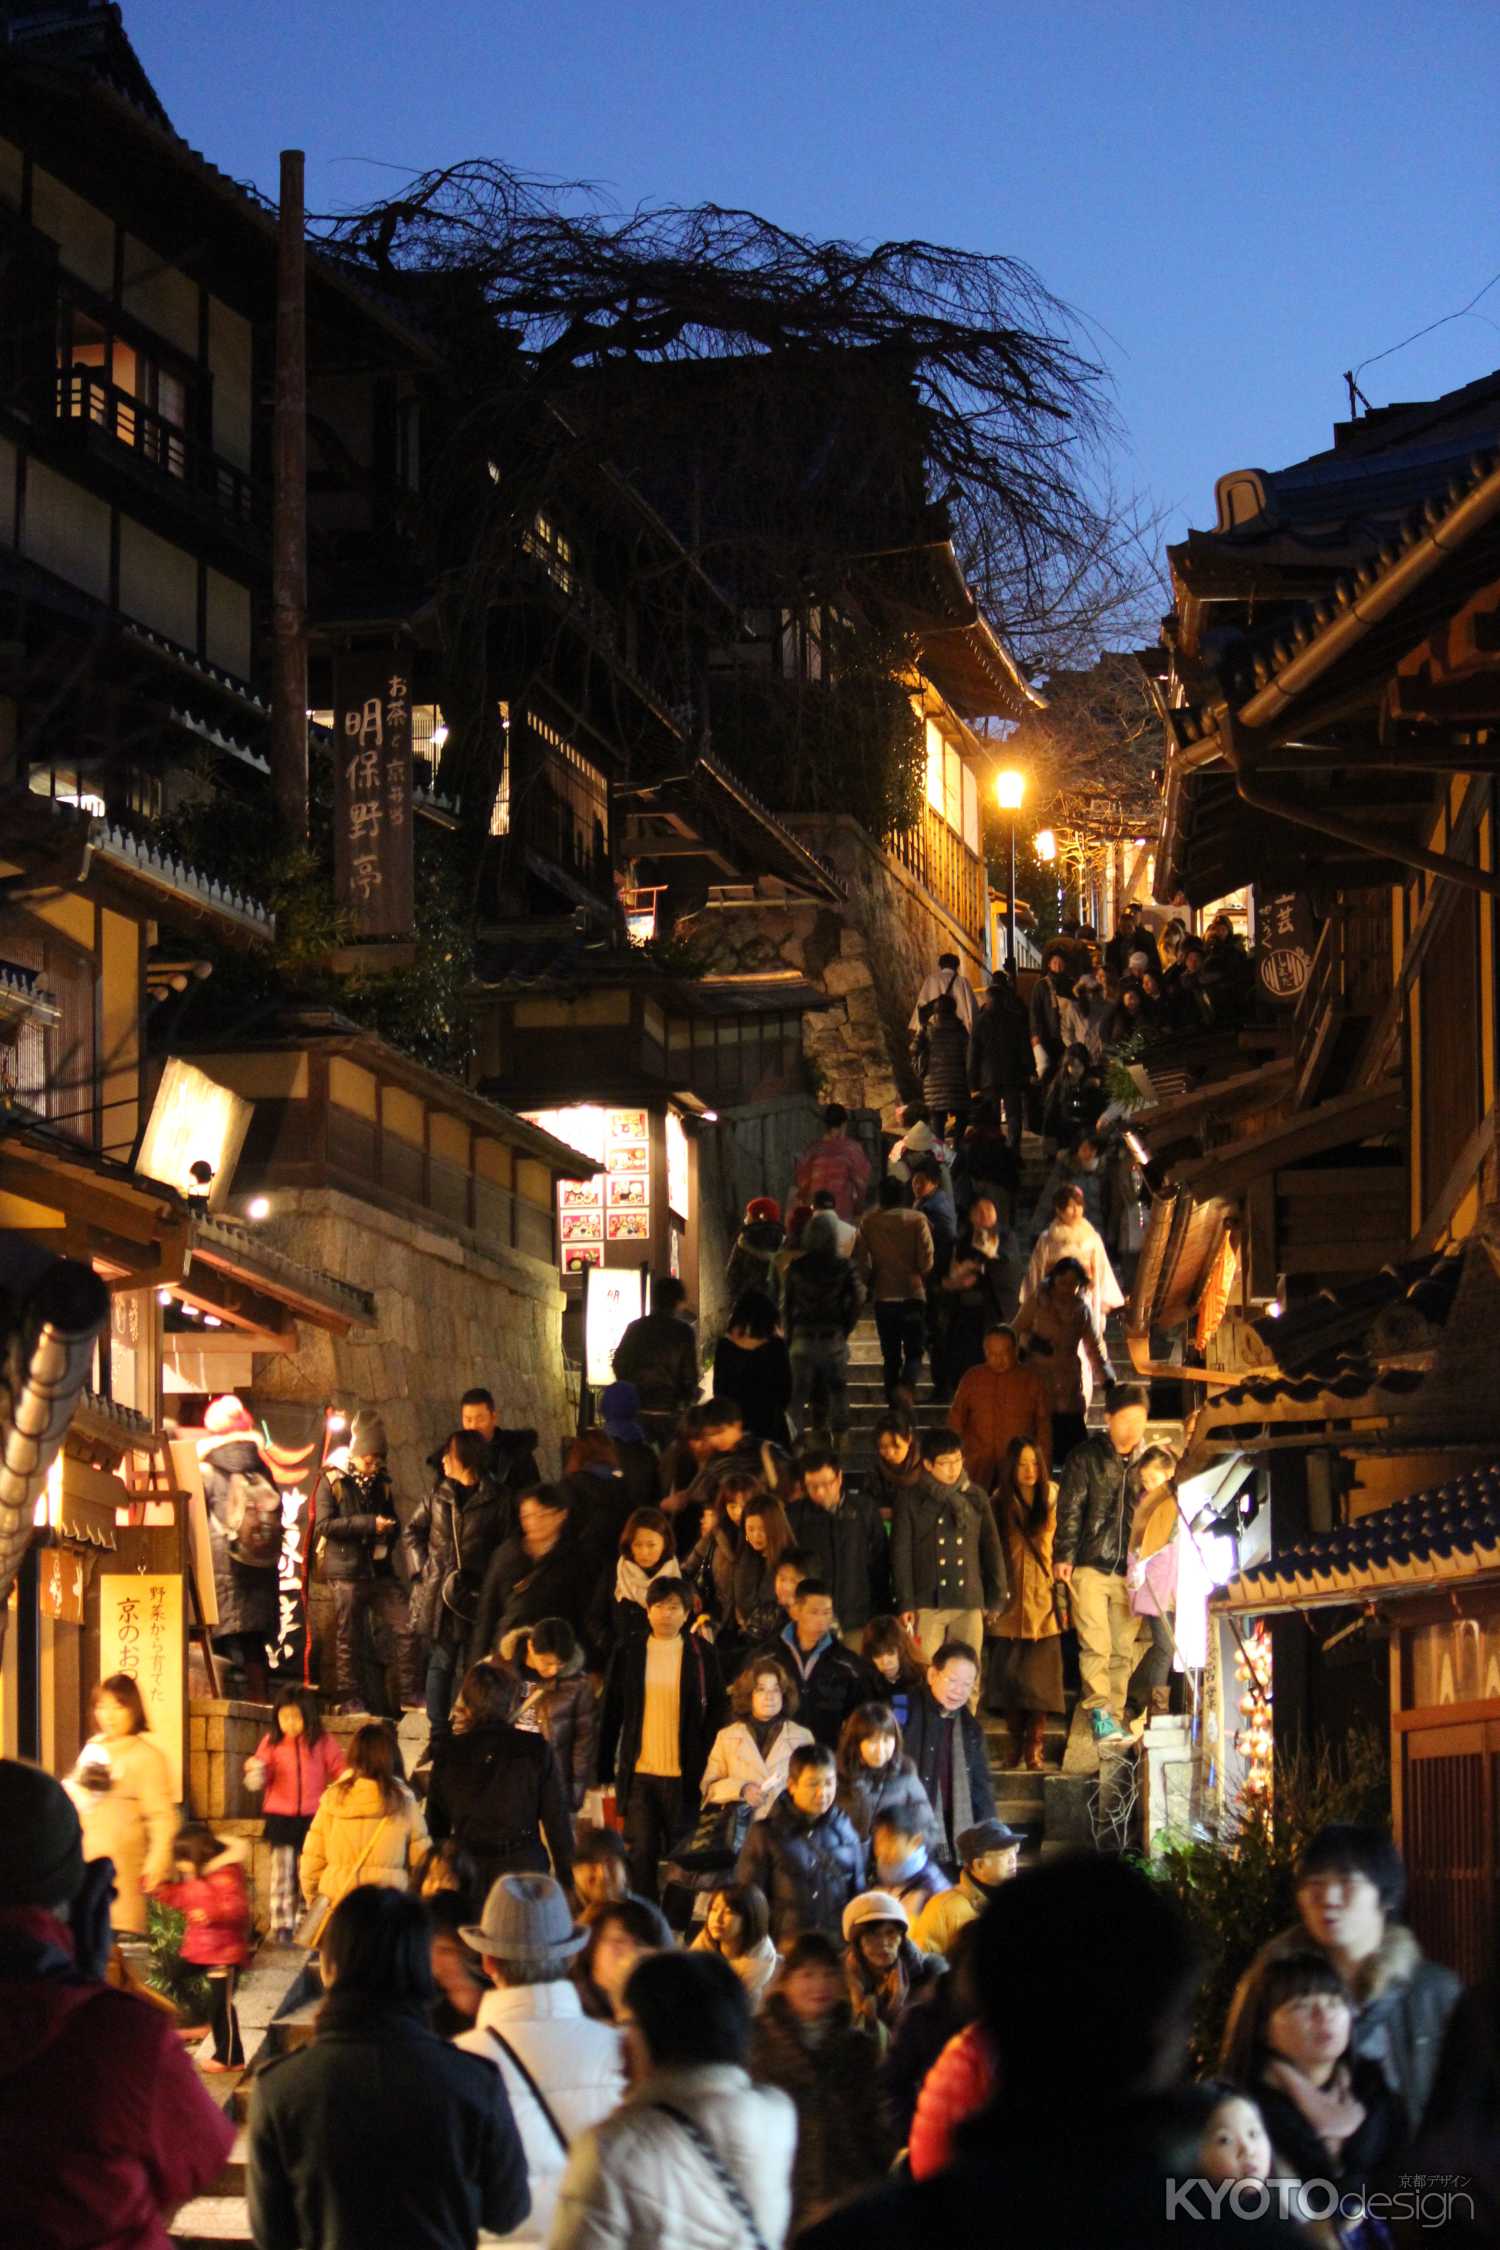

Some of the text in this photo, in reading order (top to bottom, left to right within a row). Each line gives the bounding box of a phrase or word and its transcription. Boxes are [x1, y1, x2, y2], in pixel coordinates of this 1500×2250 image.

[344, 698, 384, 899] 明保野亭
[149, 1585, 167, 1702] 野菜から育てた
